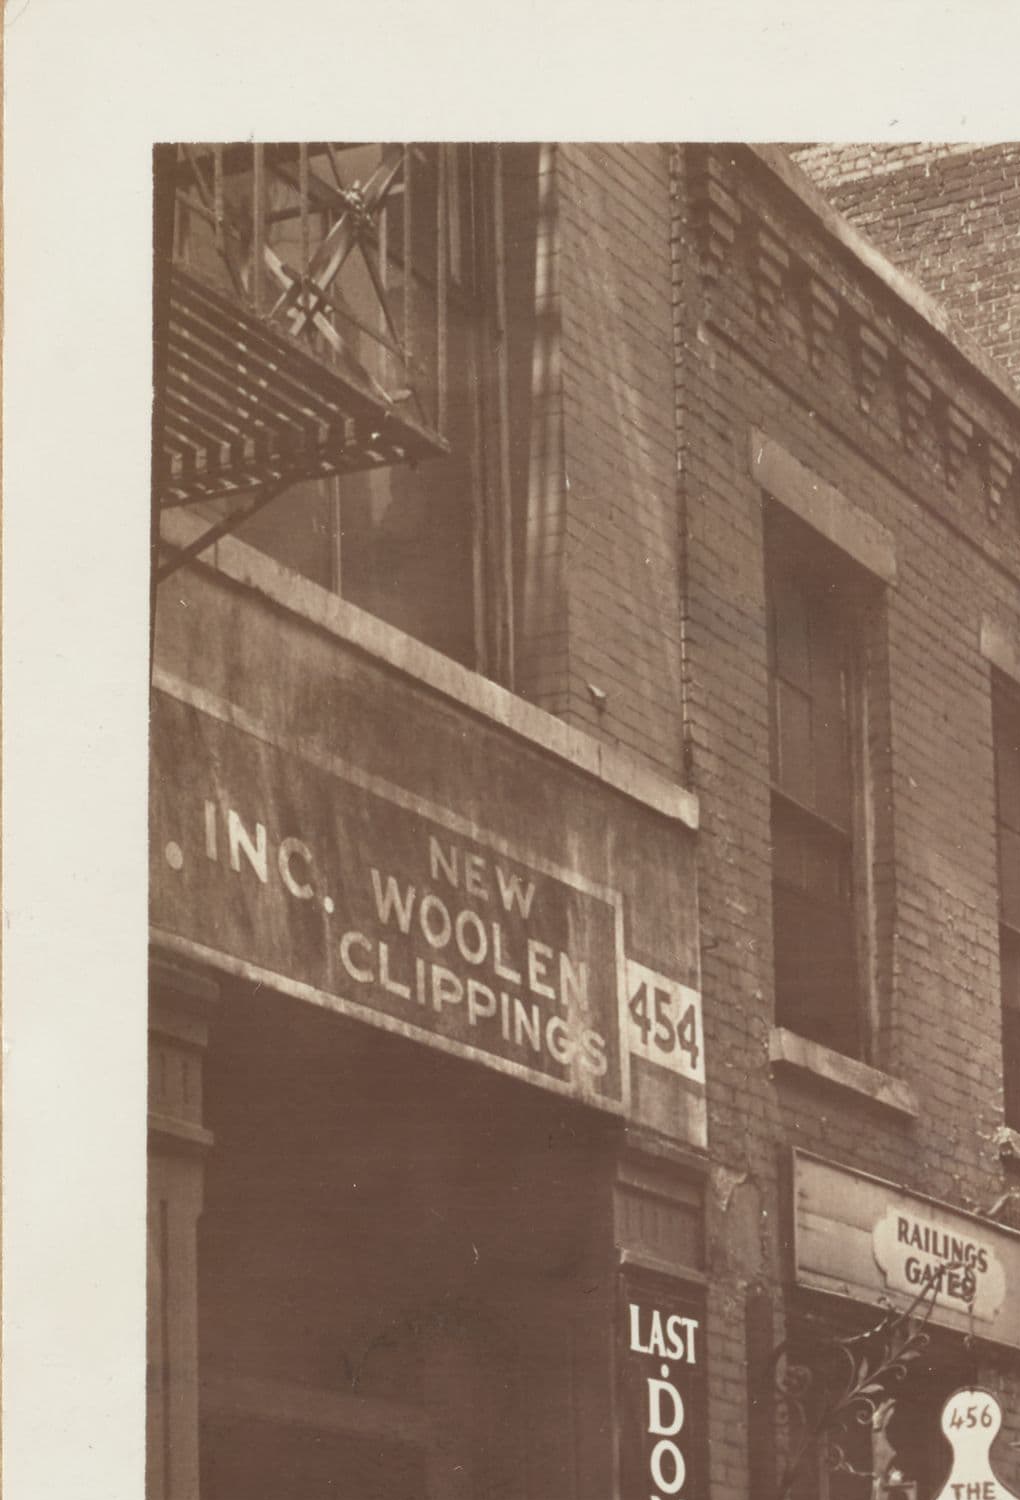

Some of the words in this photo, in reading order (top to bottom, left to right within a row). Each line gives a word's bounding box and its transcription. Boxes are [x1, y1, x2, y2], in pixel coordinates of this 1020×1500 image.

[204, 800, 334, 913] INC.
[429, 835, 535, 919] NEW
[371, 868, 588, 1011] WOOLEN
[340, 931, 609, 1077] CLIPPINGS
[627, 980, 701, 1069] 454
[898, 1216, 988, 1273] RAILINGS
[629, 1303, 699, 1364] LAST
[950, 1404, 992, 1430] 456
